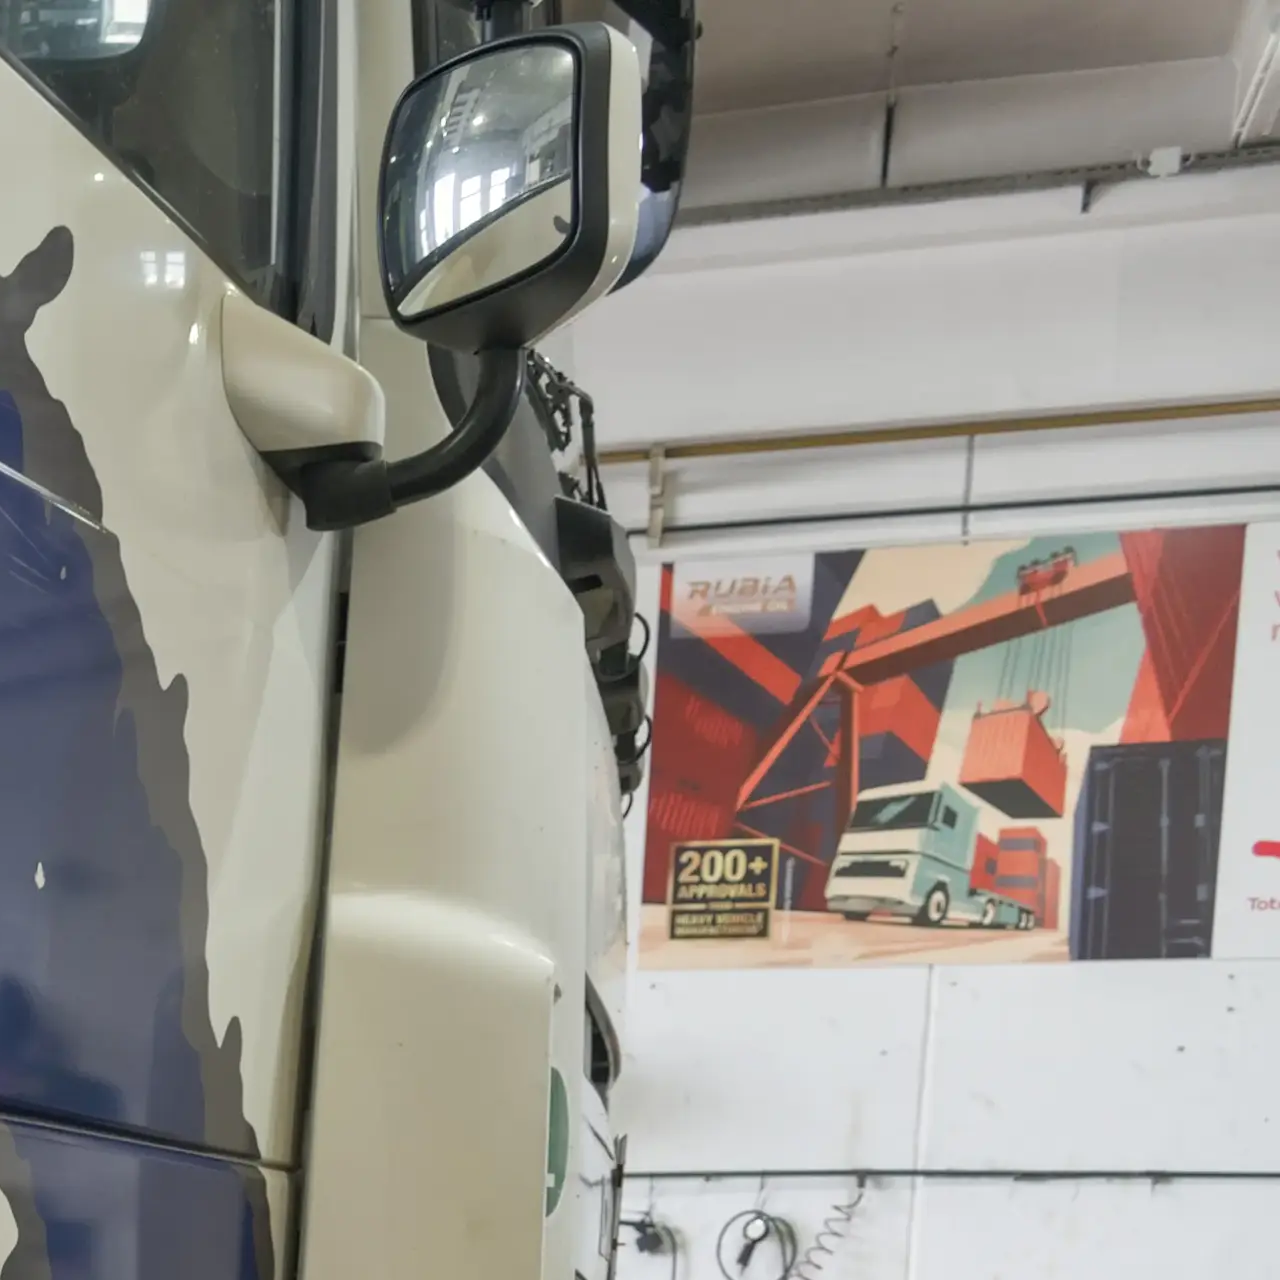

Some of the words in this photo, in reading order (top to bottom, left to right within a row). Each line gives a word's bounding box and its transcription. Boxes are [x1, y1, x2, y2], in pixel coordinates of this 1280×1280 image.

[678, 849, 768, 883] 200+
[677, 883, 767, 899] APPROVALS
[1247, 897, 1280, 912] Tot
